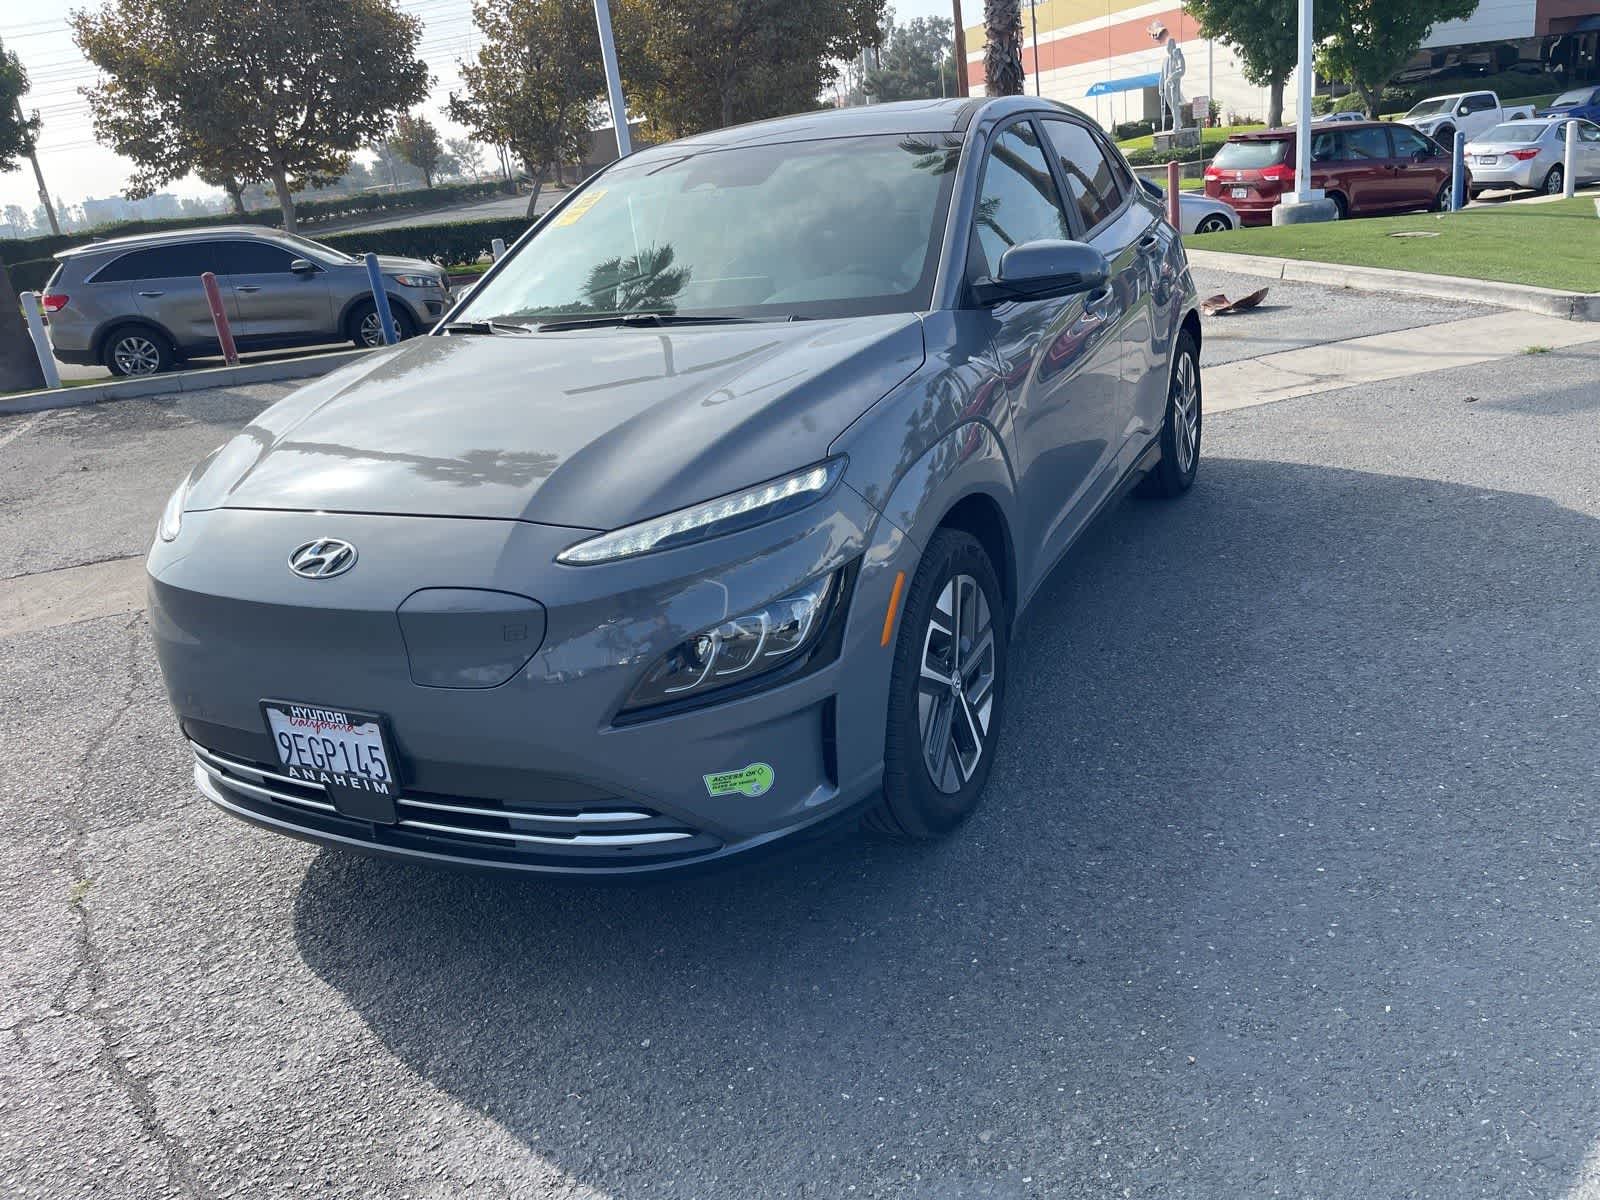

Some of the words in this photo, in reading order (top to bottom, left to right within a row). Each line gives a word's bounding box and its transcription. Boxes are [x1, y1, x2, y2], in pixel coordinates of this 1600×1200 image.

[290, 706, 349, 725] HYUNDAI
[278, 731, 388, 781] 9EGP145
[289, 767, 389, 795] ANAHEIM
